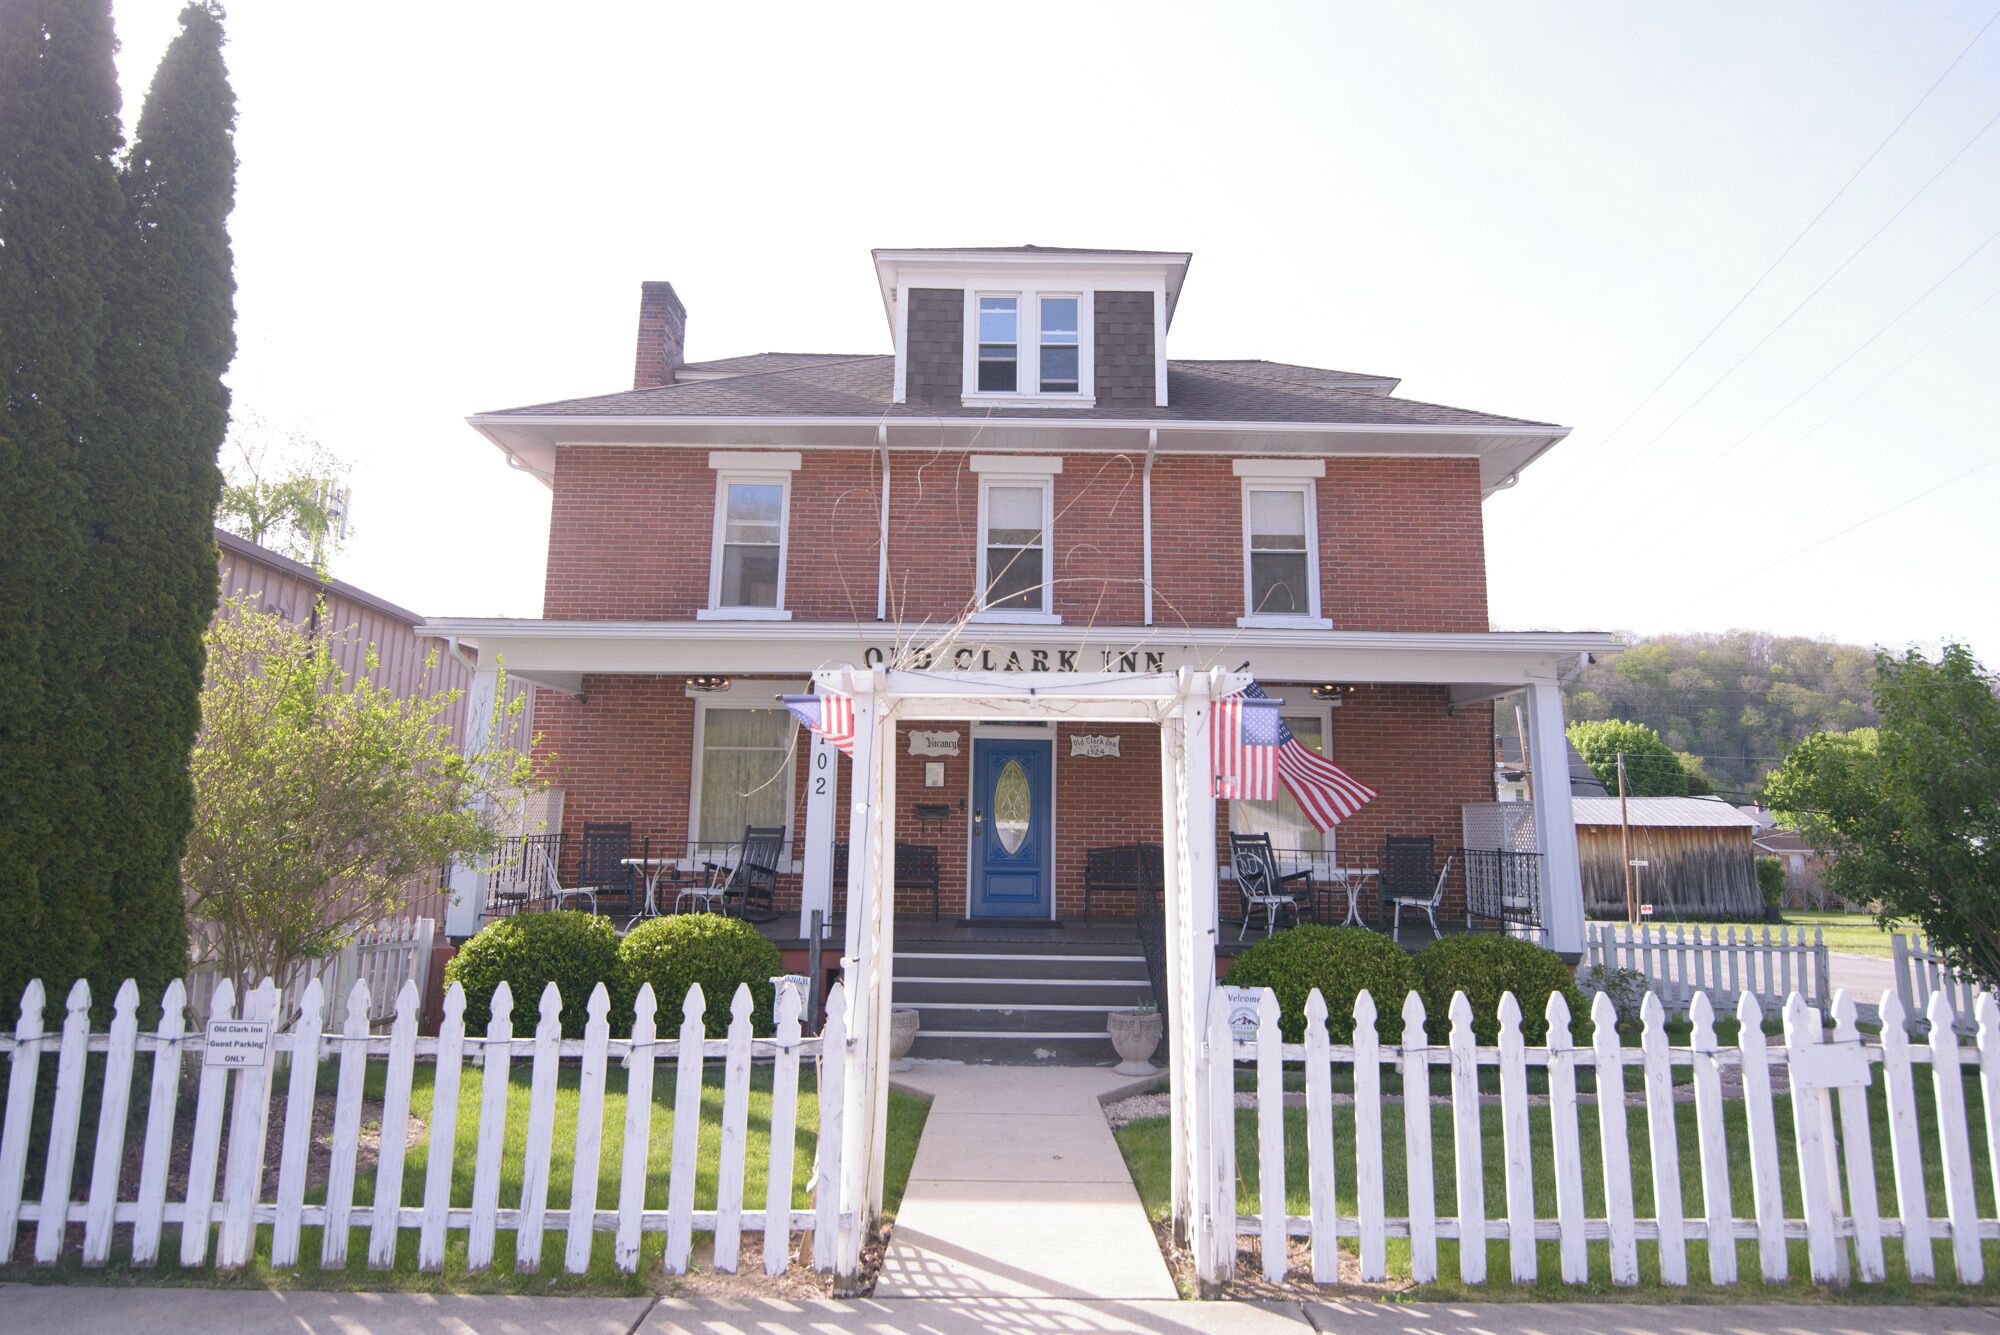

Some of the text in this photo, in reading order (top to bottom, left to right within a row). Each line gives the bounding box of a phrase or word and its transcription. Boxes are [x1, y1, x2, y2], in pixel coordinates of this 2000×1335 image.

[954, 648, 1079, 672] CLARK
[1101, 650, 1166, 673] INN
[925, 737, 957, 750] Vacancy
[1073, 737, 1117, 748] Old Clark Inn
[1087, 748, 1105, 756] 1924
[214, 1025, 227, 1033] Old
[228, 1025, 249, 1033] Clark
[209, 1040, 264, 1049] Guest Parking
[224, 1055, 246, 1063] ONLY
